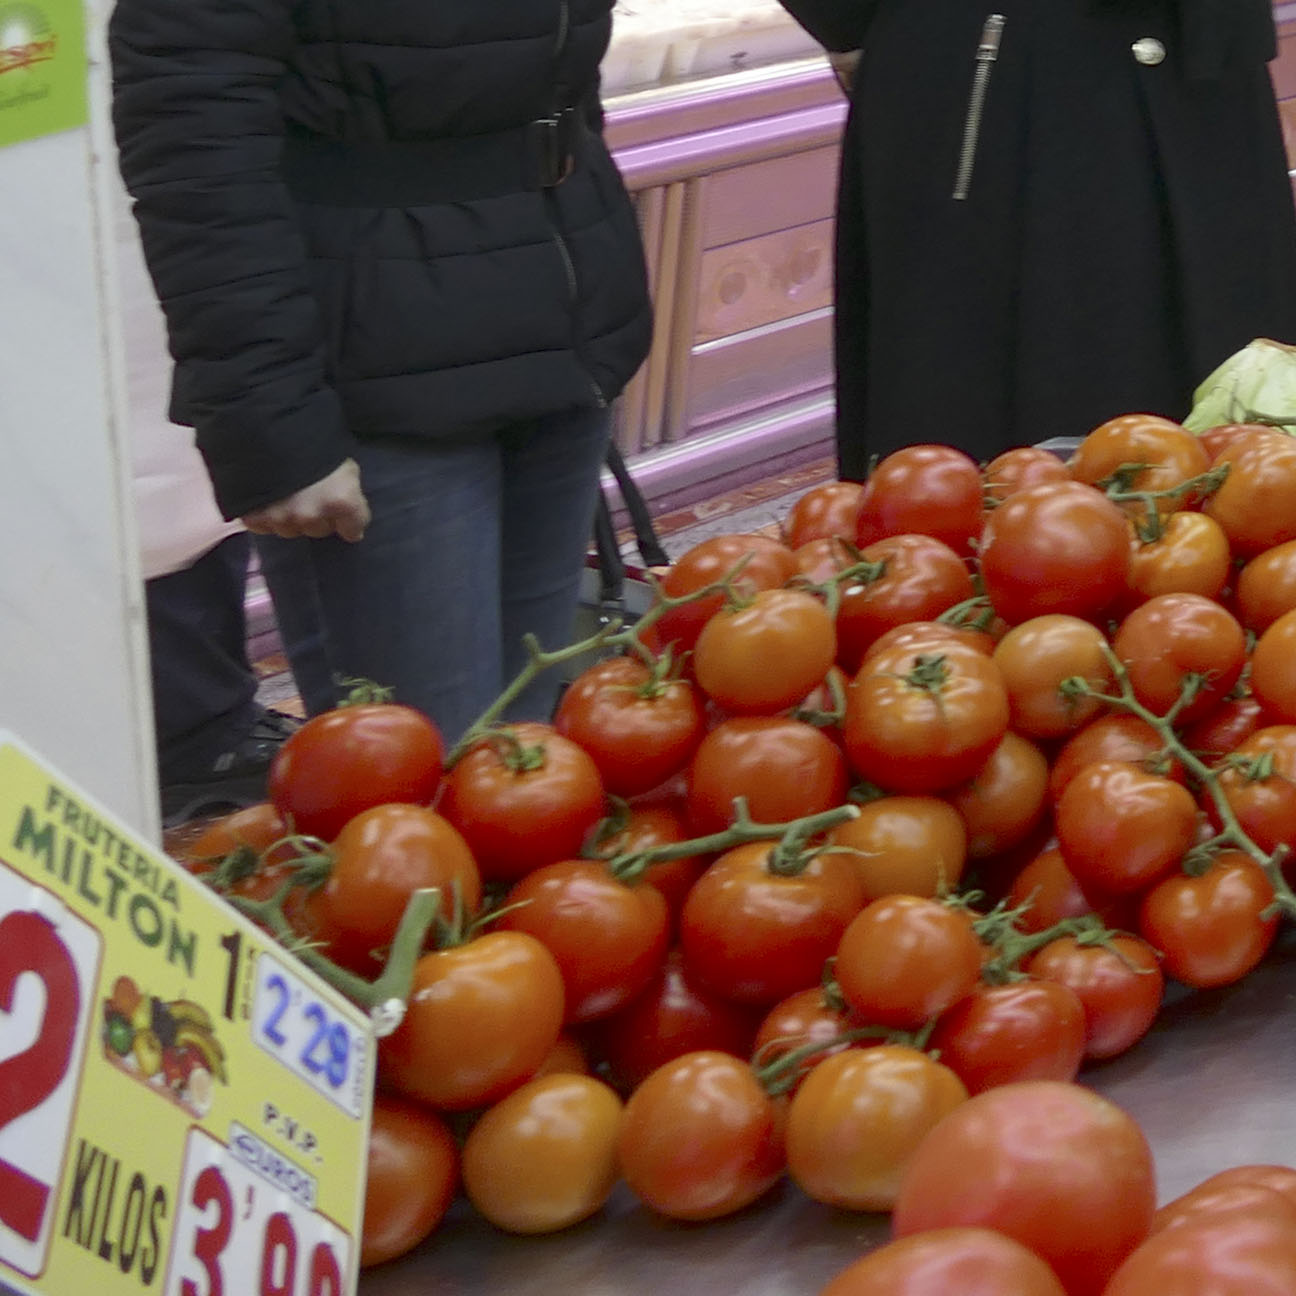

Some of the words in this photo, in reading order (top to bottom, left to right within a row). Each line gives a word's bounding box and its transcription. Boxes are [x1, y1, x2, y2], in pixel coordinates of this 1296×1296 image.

[12, 806, 200, 979] MILTON
[219, 931, 244, 1023] 1
[47, 785, 181, 916] FRUTERIA
[0, 910, 82, 1244] 2
[62, 1138, 166, 1286] KILOS
